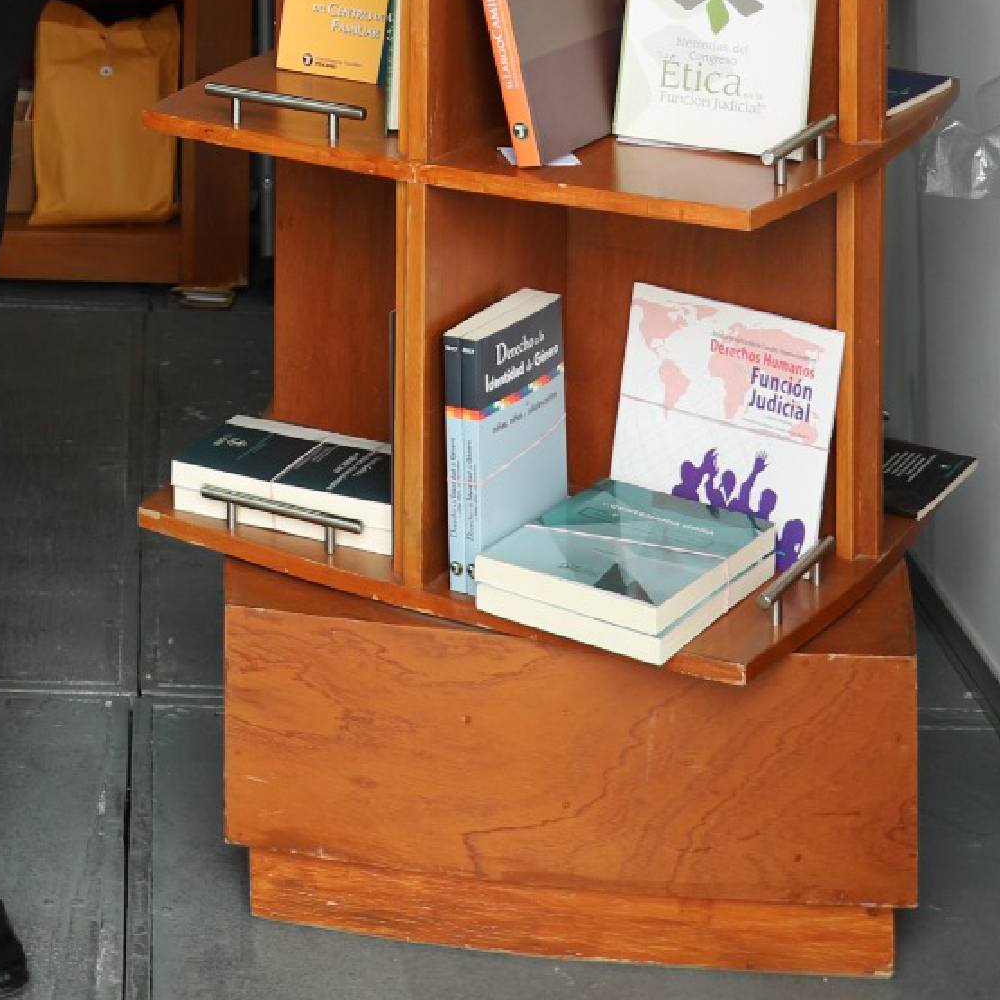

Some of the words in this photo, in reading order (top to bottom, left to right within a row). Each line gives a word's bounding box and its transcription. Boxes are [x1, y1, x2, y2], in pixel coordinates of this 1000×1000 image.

[660, 54, 742, 97] Ética
[485, 360, 525, 393] Identidad
[534, 345, 559, 367] Género
[495, 333, 535, 366] Derecho
[710, 338, 761, 364] Derechos
[763, 352, 815, 380] Humanos
[750, 365, 813, 402] Función
[748, 387, 811, 423] Judicial
